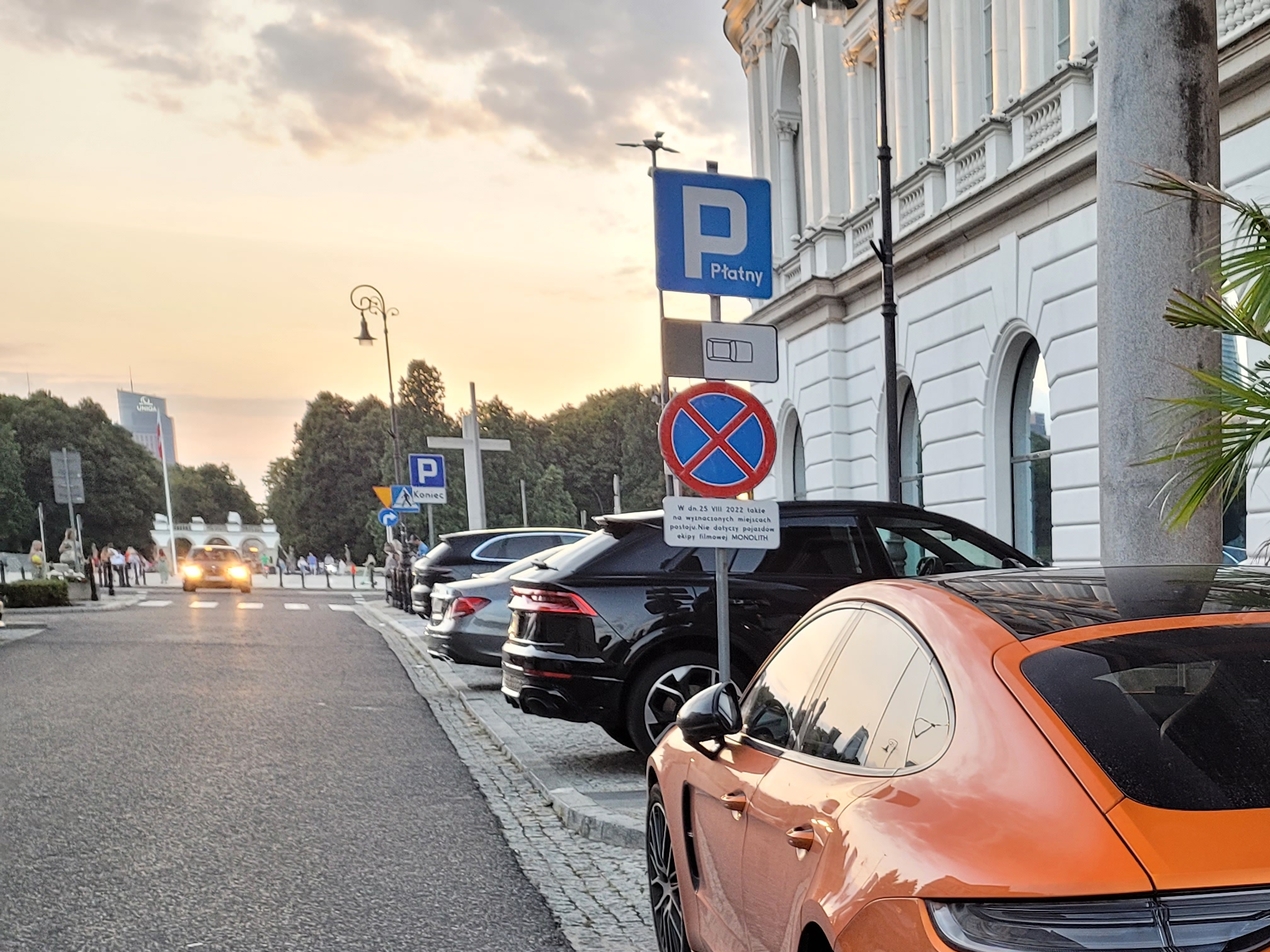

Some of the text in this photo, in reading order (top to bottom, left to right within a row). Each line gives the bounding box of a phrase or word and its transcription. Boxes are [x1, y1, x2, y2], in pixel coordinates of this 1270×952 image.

[682, 185, 748, 279] P
[710, 262, 763, 287] Płatny
[416, 458, 438, 484] P
[413, 490, 444, 499] Koniec
[711, 505, 723, 513] VIII
[713, 524, 739, 532] dotyczy
[677, 532, 695, 540] ekipy
[699, 533, 728, 541] filmowej
